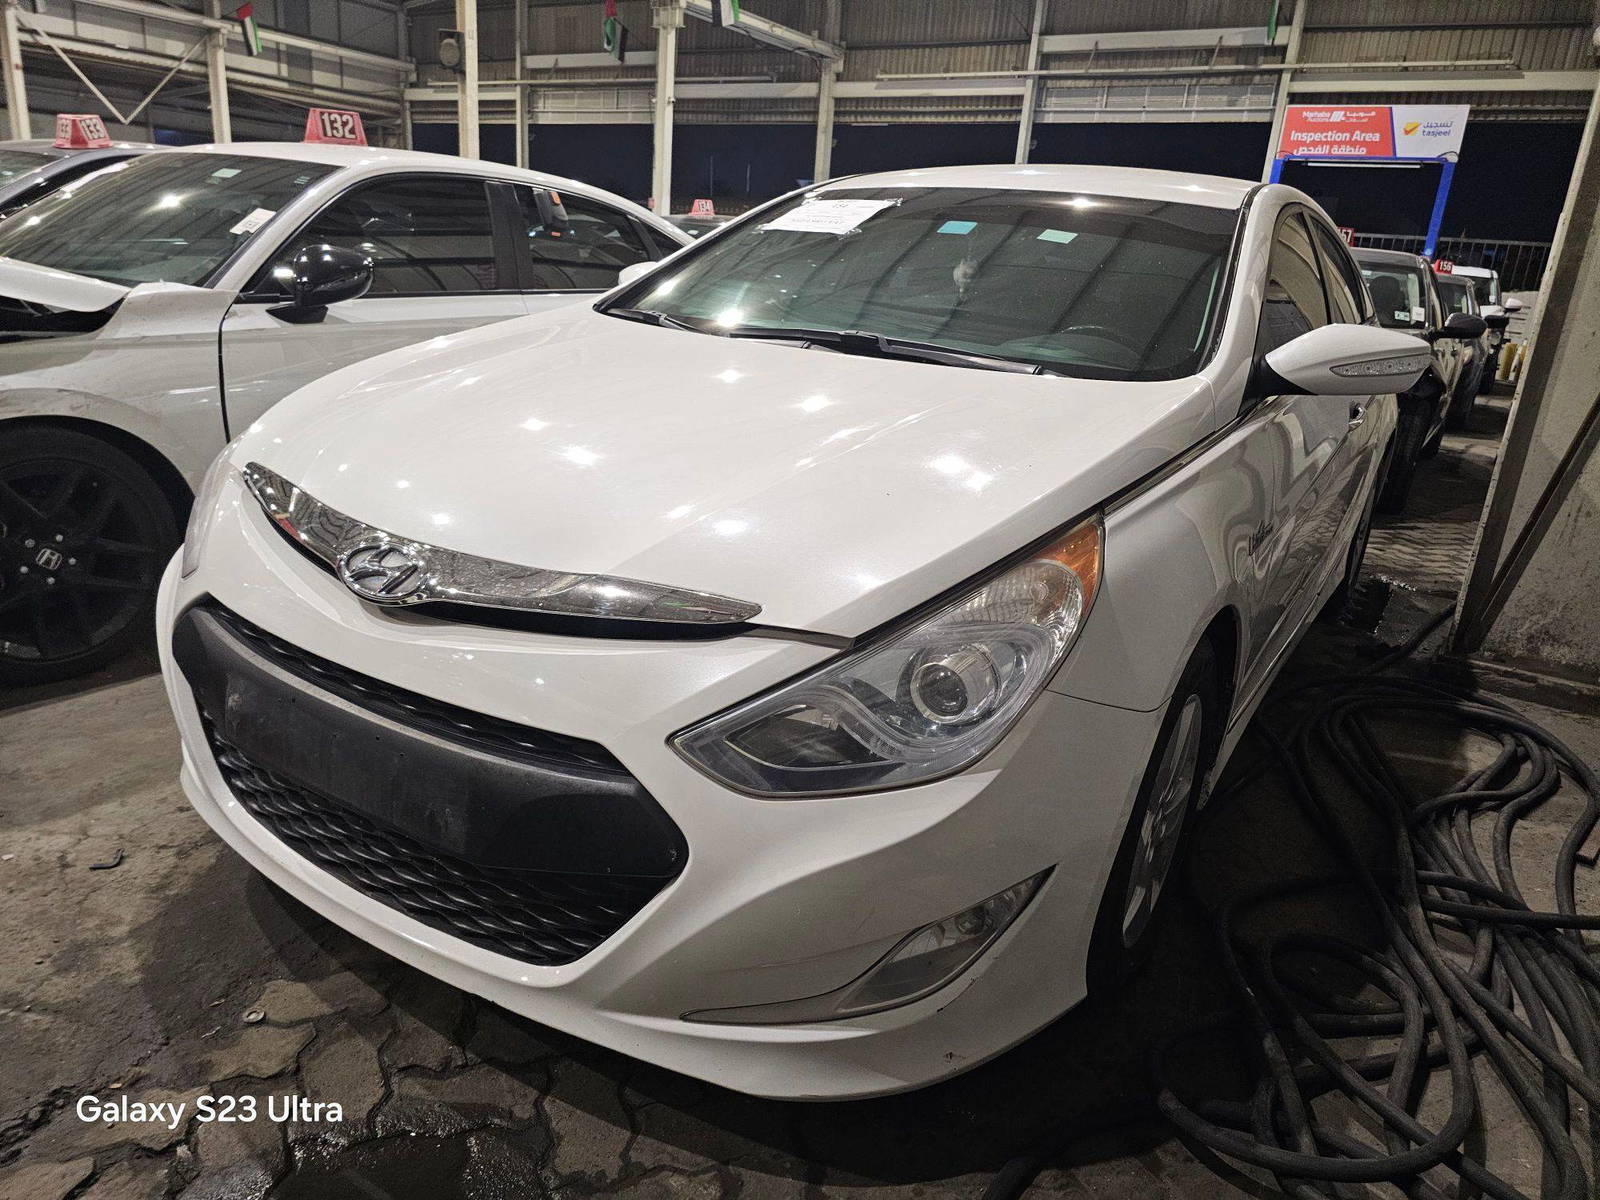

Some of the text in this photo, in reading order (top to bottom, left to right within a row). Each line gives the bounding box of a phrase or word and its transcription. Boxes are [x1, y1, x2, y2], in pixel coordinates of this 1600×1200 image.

[80, 118, 105, 140] 133
[321, 111, 356, 139] 132
[1290, 130, 1380, 143] Inspection Area
[1422, 129, 1451, 137] tasjeel
[1293, 145, 1367, 155] منطقة الفحص
[1339, 229, 1352, 243] 57
[1439, 261, 1451, 272] 156
